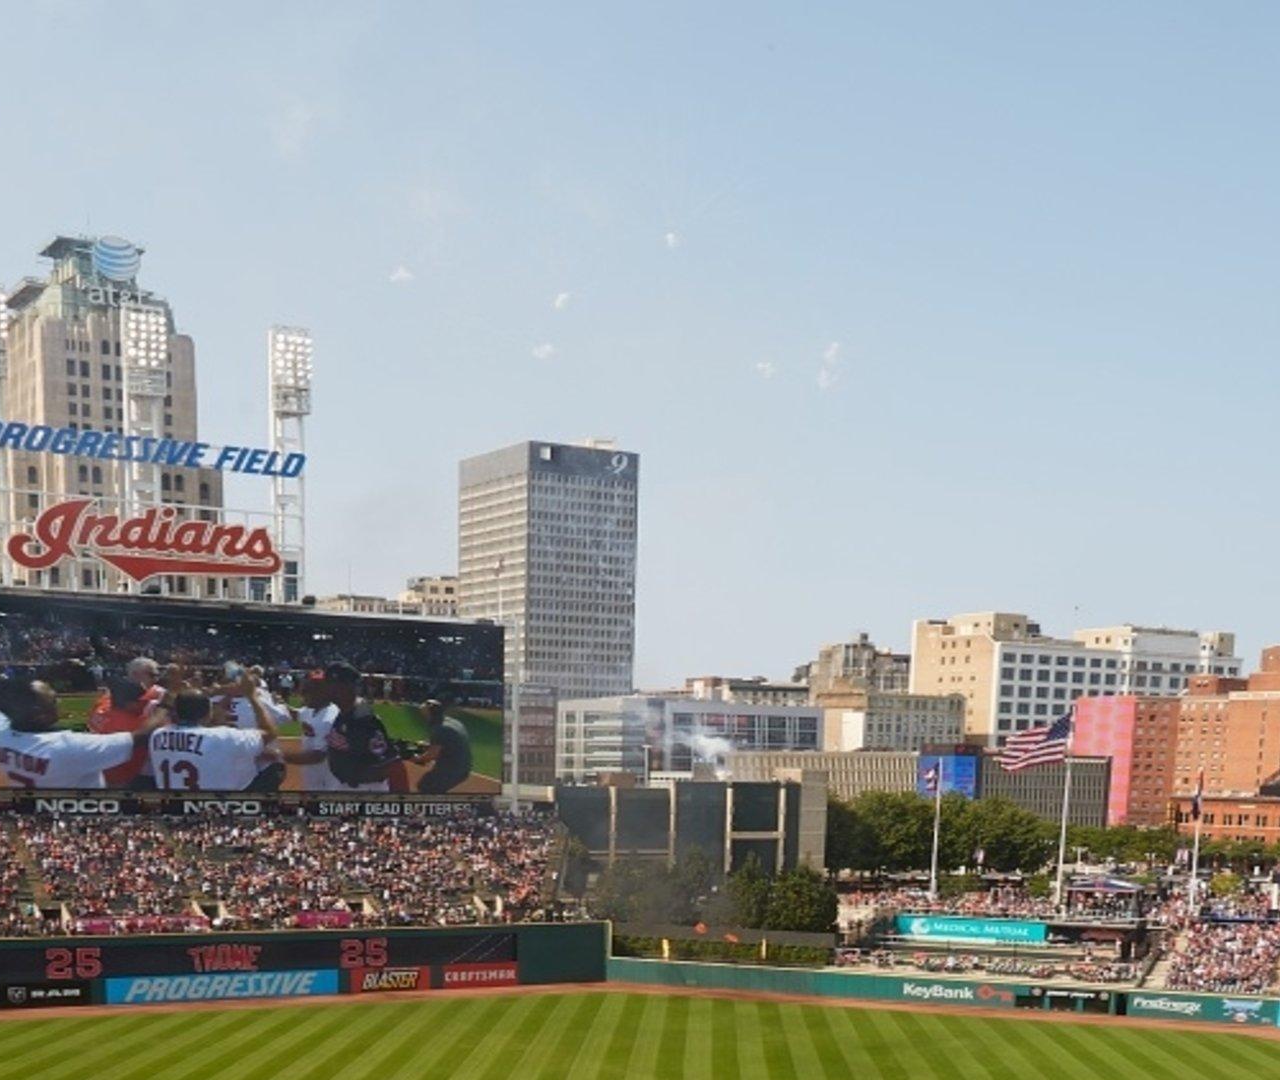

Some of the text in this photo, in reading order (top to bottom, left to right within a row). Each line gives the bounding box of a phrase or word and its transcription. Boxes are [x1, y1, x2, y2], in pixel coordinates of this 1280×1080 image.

[88, 285, 153, 306] at&t
[215, 446, 307, 478] FIELD
[7, 499, 283, 582] Indians
[160, 759, 201, 790] 13
[35, 799, 120, 814] NOCO
[183, 800, 261, 815] NOCO
[319, 801, 360, 815] START
[364, 802, 401, 815] DEAD
[45, 947, 103, 980] 25
[187, 944, 262, 972] THOME
[340, 936, 388, 969] 25
[124, 971, 319, 1002] PROGRESSIVE
[443, 969, 517, 982] CRAFTSMAN
[902, 981, 974, 1001] KeyBank
